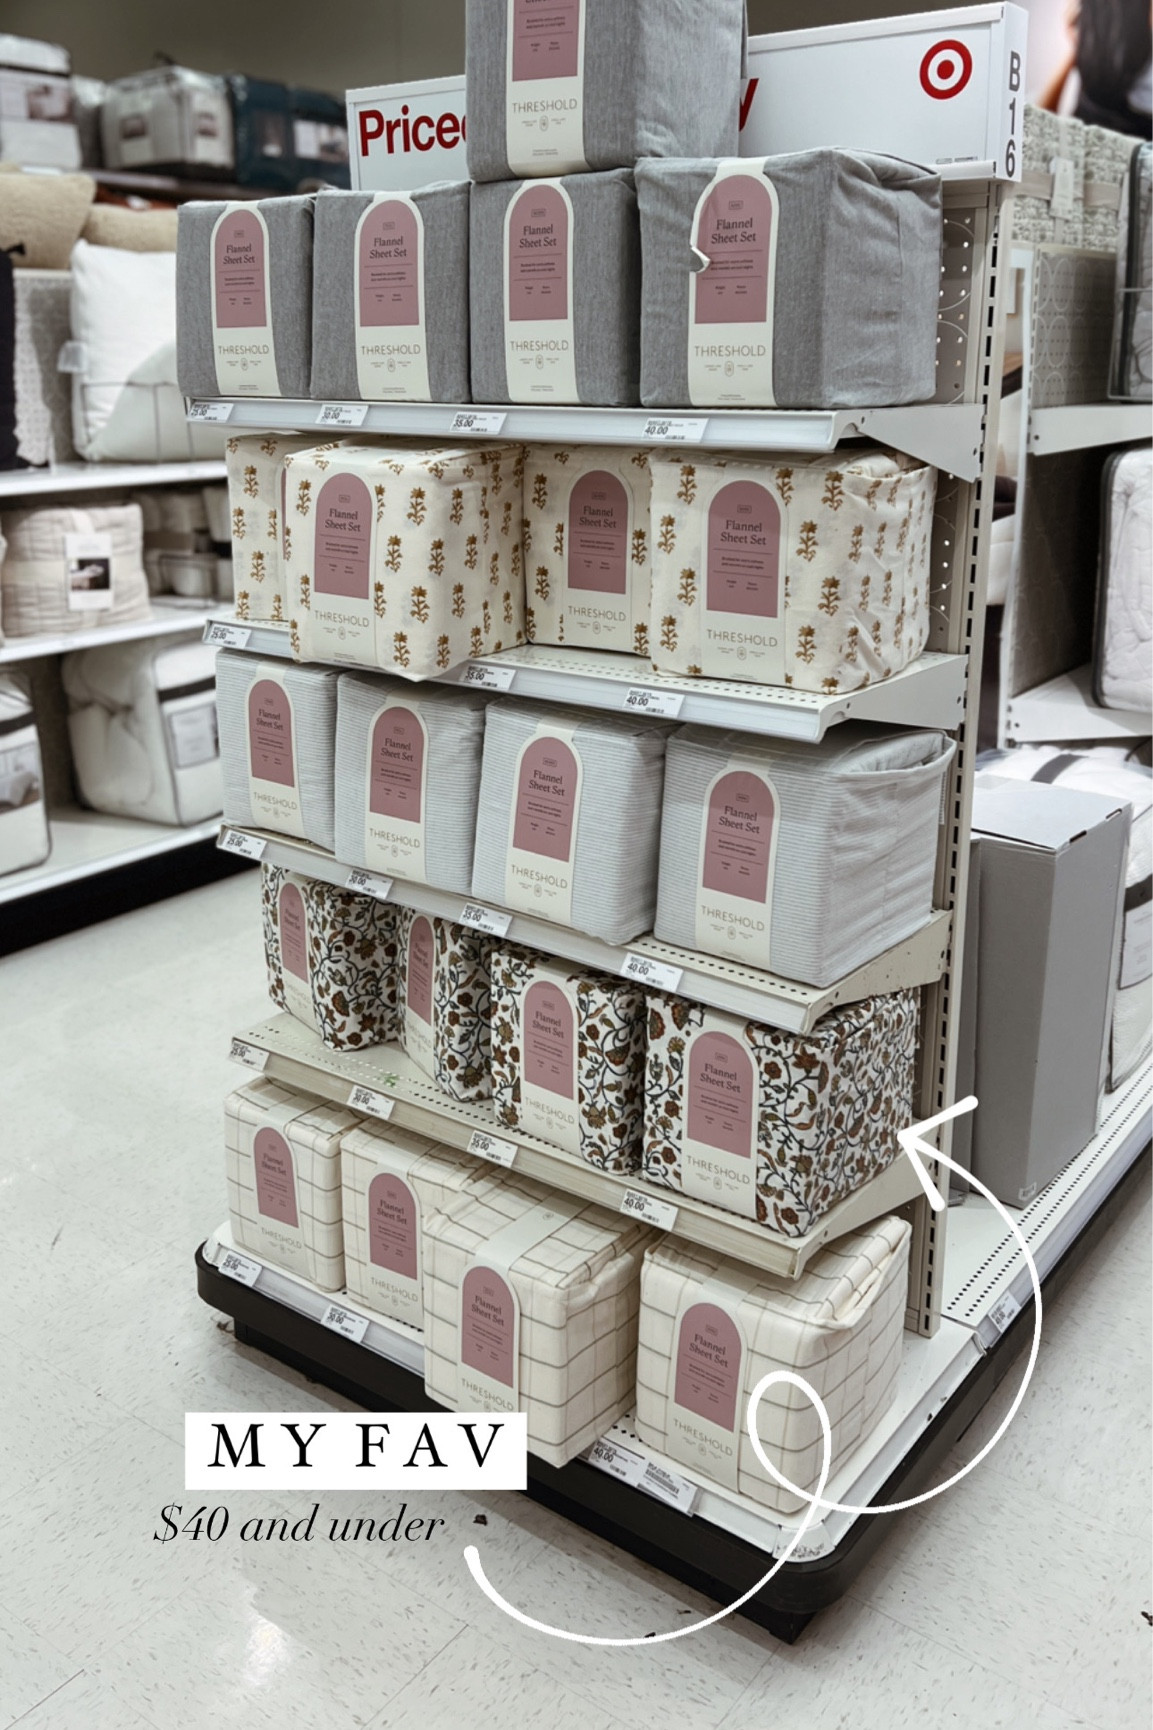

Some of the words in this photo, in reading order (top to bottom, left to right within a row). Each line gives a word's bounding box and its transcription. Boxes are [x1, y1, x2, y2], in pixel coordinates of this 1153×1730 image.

[512, 98, 577, 114] THRESHOLD
[358, 105, 467, 157] Price
[522, 224, 554, 236] Flannel
[716, 217, 753, 230] Flannel
[374, 236, 404, 248] Flannel
[519, 237, 542, 248] Sheet
[543, 236, 556, 248] Set
[711, 233, 738, 244] Sheet
[740, 232, 756, 242] Set
[226, 243, 252, 254] Flannel
[369, 249, 392, 260] Sheet
[394, 248, 407, 258] Set
[223, 254, 242, 264] Sheet
[242, 254, 255, 264] Set
[218, 345, 270, 355] THRESHOLD
[361, 344, 420, 355] THRESHOLD
[510, 340, 568, 352] THRESHOLD
[694, 344, 766, 357] THRESHOLD
[644, 426, 668, 435] 40.00
[329, 508, 358, 522] Flannel
[583, 506, 614, 518] Flannel
[324, 520, 346, 532] Sheet
[348, 521, 361, 532] Set
[579, 516, 603, 528] Sheet
[604, 518, 617, 528] Set
[726, 520, 762, 532] Flannel
[720, 532, 748, 544] Sheet
[750, 535, 767, 546] Set
[314, 610, 370, 628] THRESHOLD
[568, 606, 626, 622] THRESHOLD
[706, 629, 778, 648] THRESHOLD
[465, 672, 485, 680] 35.00
[626, 696, 649, 706] 40.00
[258, 708, 281, 721] Flannel
[256, 718, 271, 729] Sheet
[272, 720, 284, 732] Set
[384, 738, 412, 752] Flannel
[380, 748, 399, 760] Sheet
[400, 751, 414, 762] Set
[533, 770, 564, 785] Flannel
[528, 780, 550, 794] Sheet
[551, 785, 565, 797] Set
[254, 792, 298, 810] THRESHOLD
[724, 805, 758, 822] Flannel
[718, 816, 745, 830] Sheet
[746, 822, 760, 834] Set
[370, 828, 420, 848] THRESHOLD
[510, 865, 568, 890] THRESHOLD
[701, 906, 765, 932] THRESHOLD
[628, 963, 649, 976] 40.00
[534, 1012, 562, 1027] Flannel
[532, 1020, 552, 1034] Sheet
[552, 1027, 565, 1040] Set
[704, 1063, 738, 1082] Flannel
[700, 1073, 726, 1089] Sheet
[726, 1081, 742, 1094] Set
[524, 1096, 576, 1125] THRESHOLD
[264, 1152, 284, 1166] Flannel
[260, 1160, 276, 1174] Sheet
[276, 1166, 287, 1177] Set
[686, 1156, 750, 1184] THRESHOLD
[380, 1199, 404, 1214] Flannel
[624, 1198, 645, 1212] 40.00
[376, 1208, 394, 1221] Sheet
[396, 1214, 408, 1226] Set
[260, 1227, 302, 1248] THRESHOLD
[370, 1276, 418, 1302] THRESHOLD
[475, 1296, 502, 1316] Flannel
[470, 1304, 491, 1320] Sheet
[492, 1314, 505, 1328] Set
[694, 1334, 726, 1356] Flannel
[688, 1342, 712, 1362] Sheet
[714, 1354, 729, 1368] Set
[461, 1378, 514, 1412] THRESHOLD
[673, 1418, 734, 1456] THRESHOLD
[594, 1446, 614, 1462] 40.00
